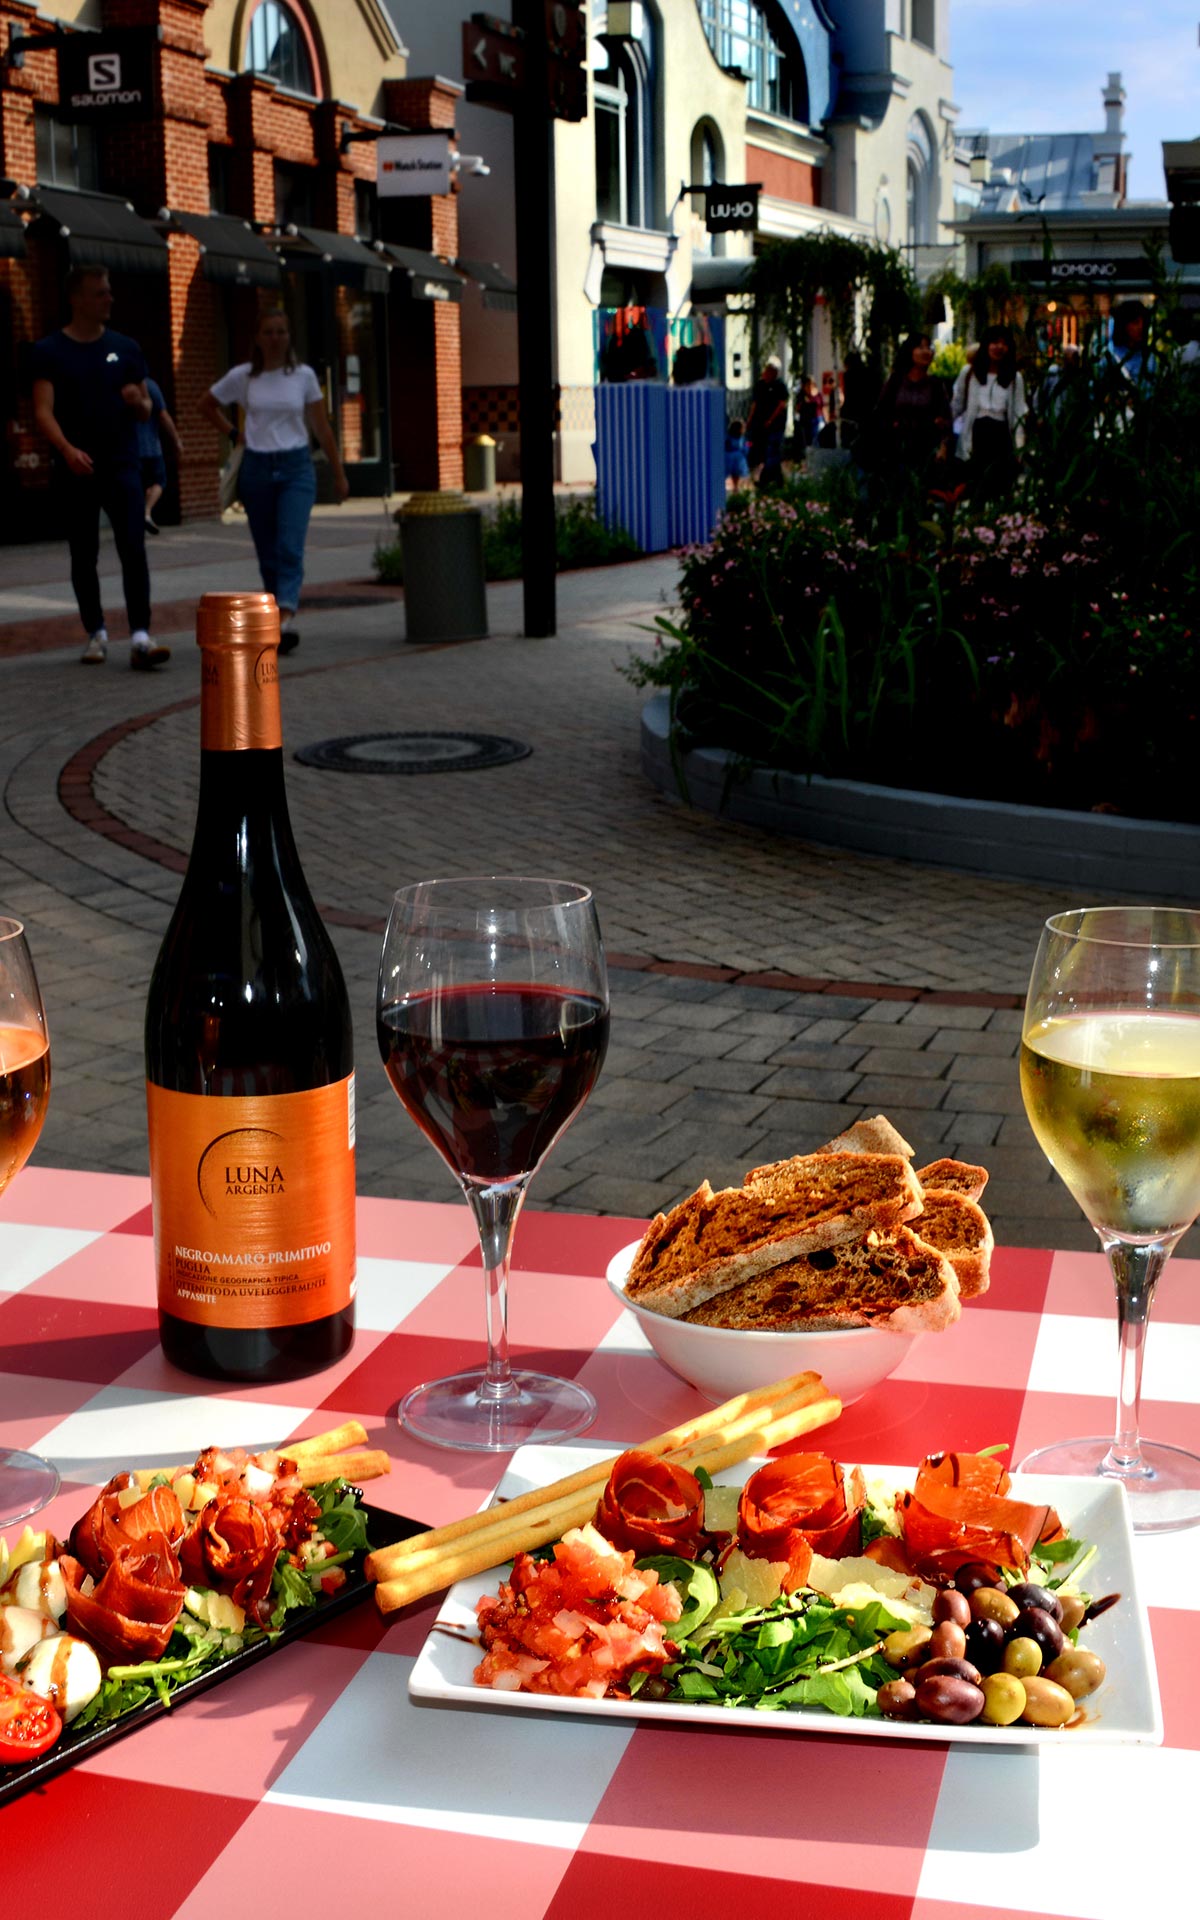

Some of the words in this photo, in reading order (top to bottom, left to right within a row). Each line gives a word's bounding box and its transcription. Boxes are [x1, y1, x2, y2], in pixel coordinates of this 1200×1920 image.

[1051, 263, 1117, 277] KOMONO
[225, 1166, 284, 1183] LUNA
[225, 1183, 285, 1195] ARGENTA
[175, 1245, 266, 1265] NEGROAMARO
[268, 1241, 332, 1264] PRIMITIVO
[175, 1257, 211, 1274] PUGLIA
[273, 1273, 299, 1283] TIPICA
[177, 1288, 217, 1304] APPASSITE
